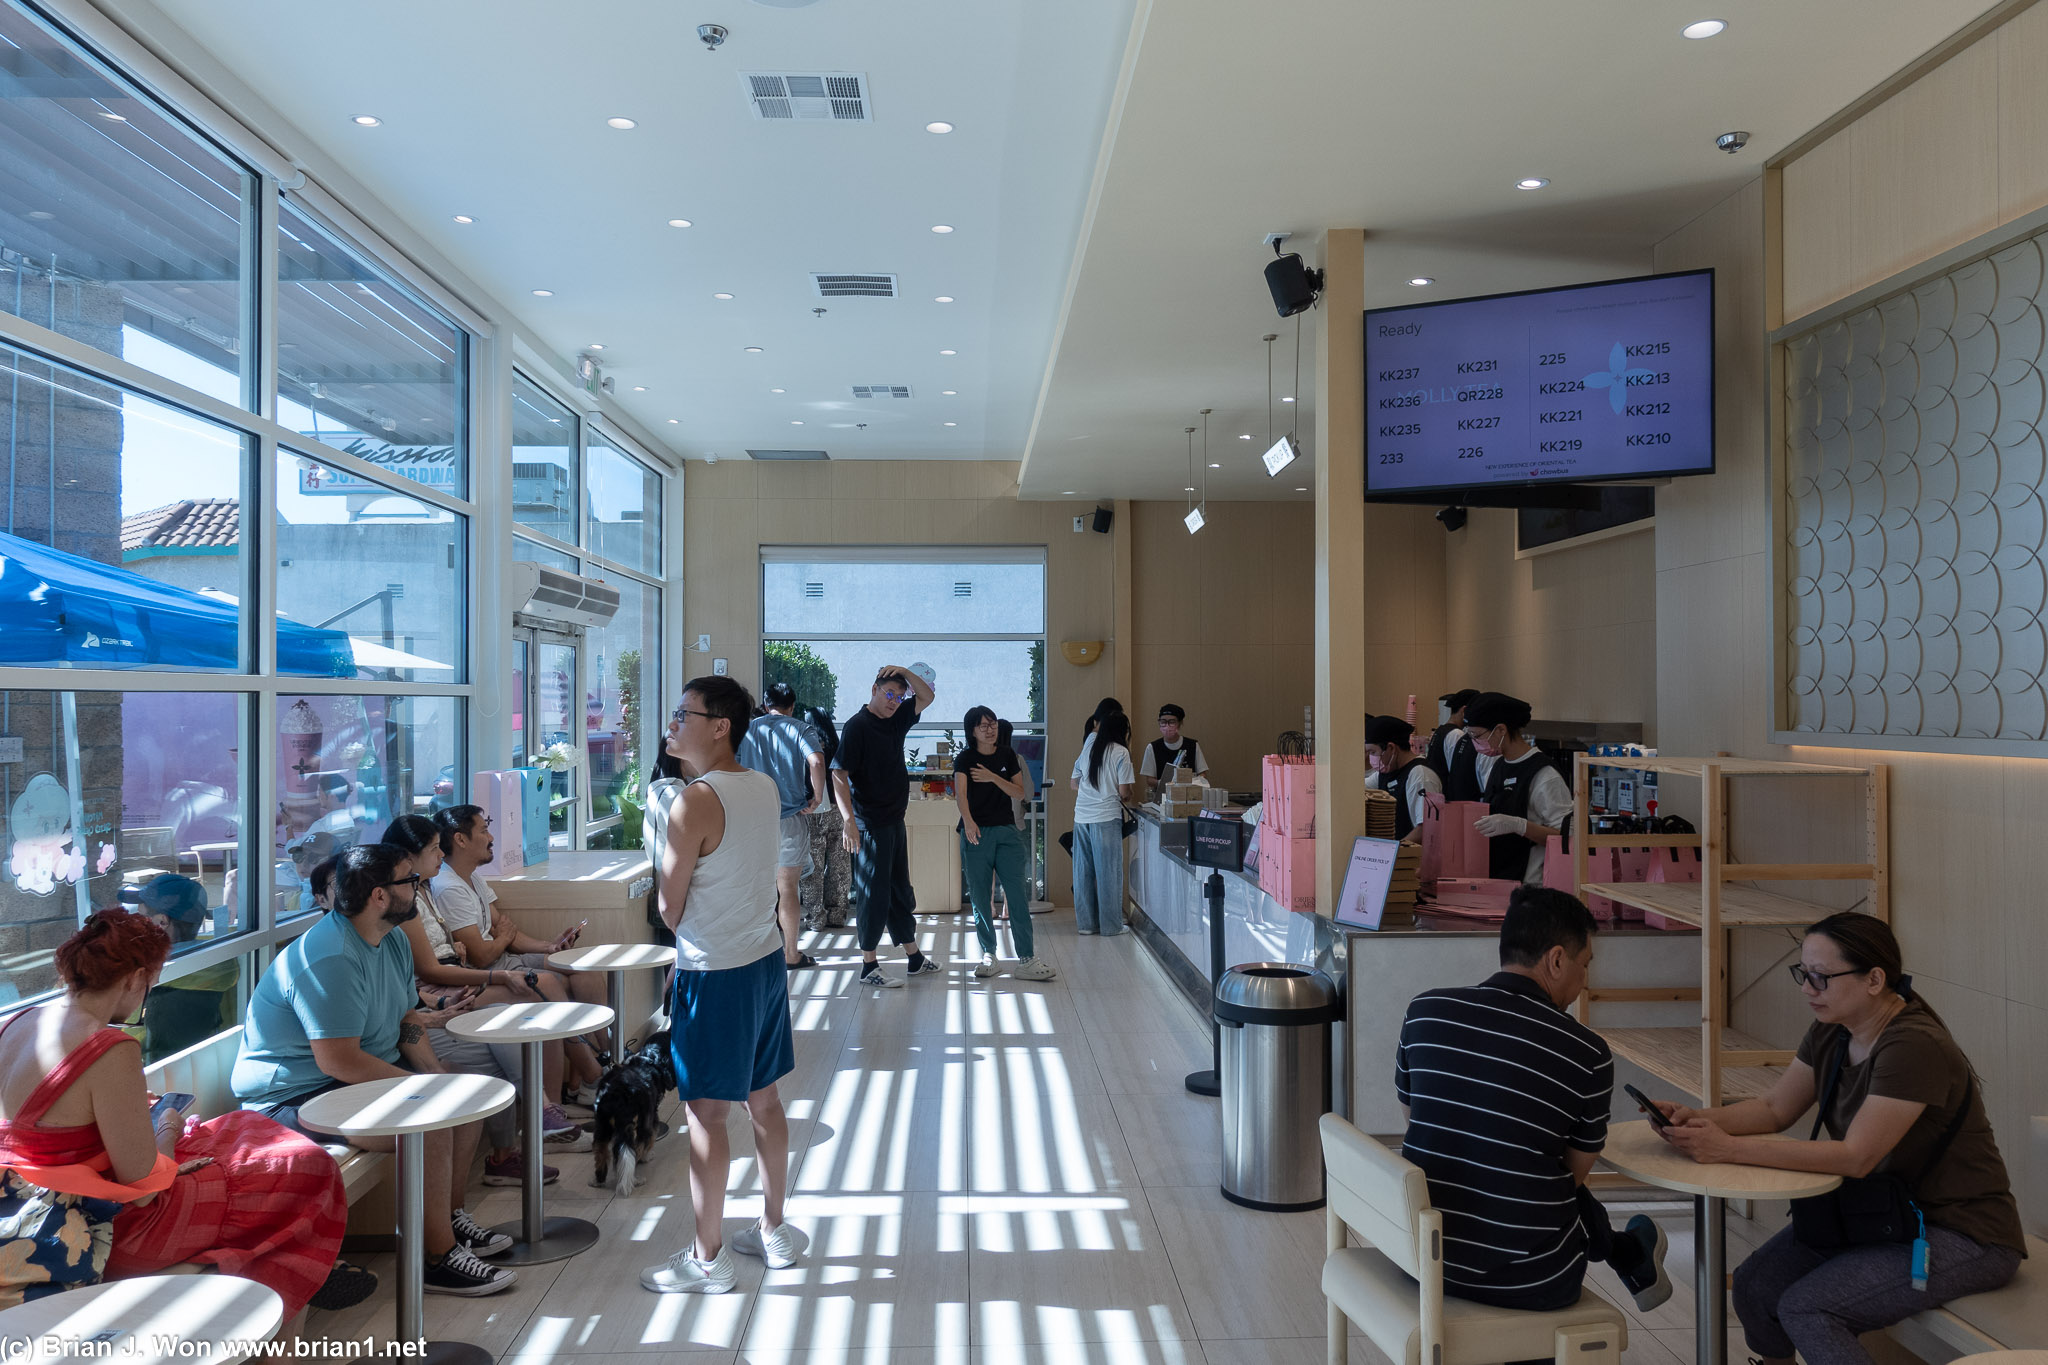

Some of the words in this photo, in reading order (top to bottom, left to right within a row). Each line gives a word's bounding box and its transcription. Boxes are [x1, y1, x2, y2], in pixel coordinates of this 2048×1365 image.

[1379, 322, 1422, 338] Ready
[1626, 342, 1670, 357] KK215
[1539, 353, 1566, 366] 225
[1379, 368, 1420, 382] KK237
[1457, 360, 1498, 375] KK231
[1540, 380, 1585, 395] KK224
[1626, 373, 1670, 387] KK213
[1379, 395, 1421, 410] KK236
[1457, 388, 1503, 403] QR228
[1540, 410, 1582, 424] KK221
[1626, 403, 1670, 417] KK212
[1380, 423, 1421, 438] KK235
[1457, 416, 1501, 431] KK227
[1540, 439, 1582, 454] KK219
[1626, 433, 1671, 447] KK210
[1380, 453, 1404, 465] 233
[1458, 447, 1483, 459] 226
